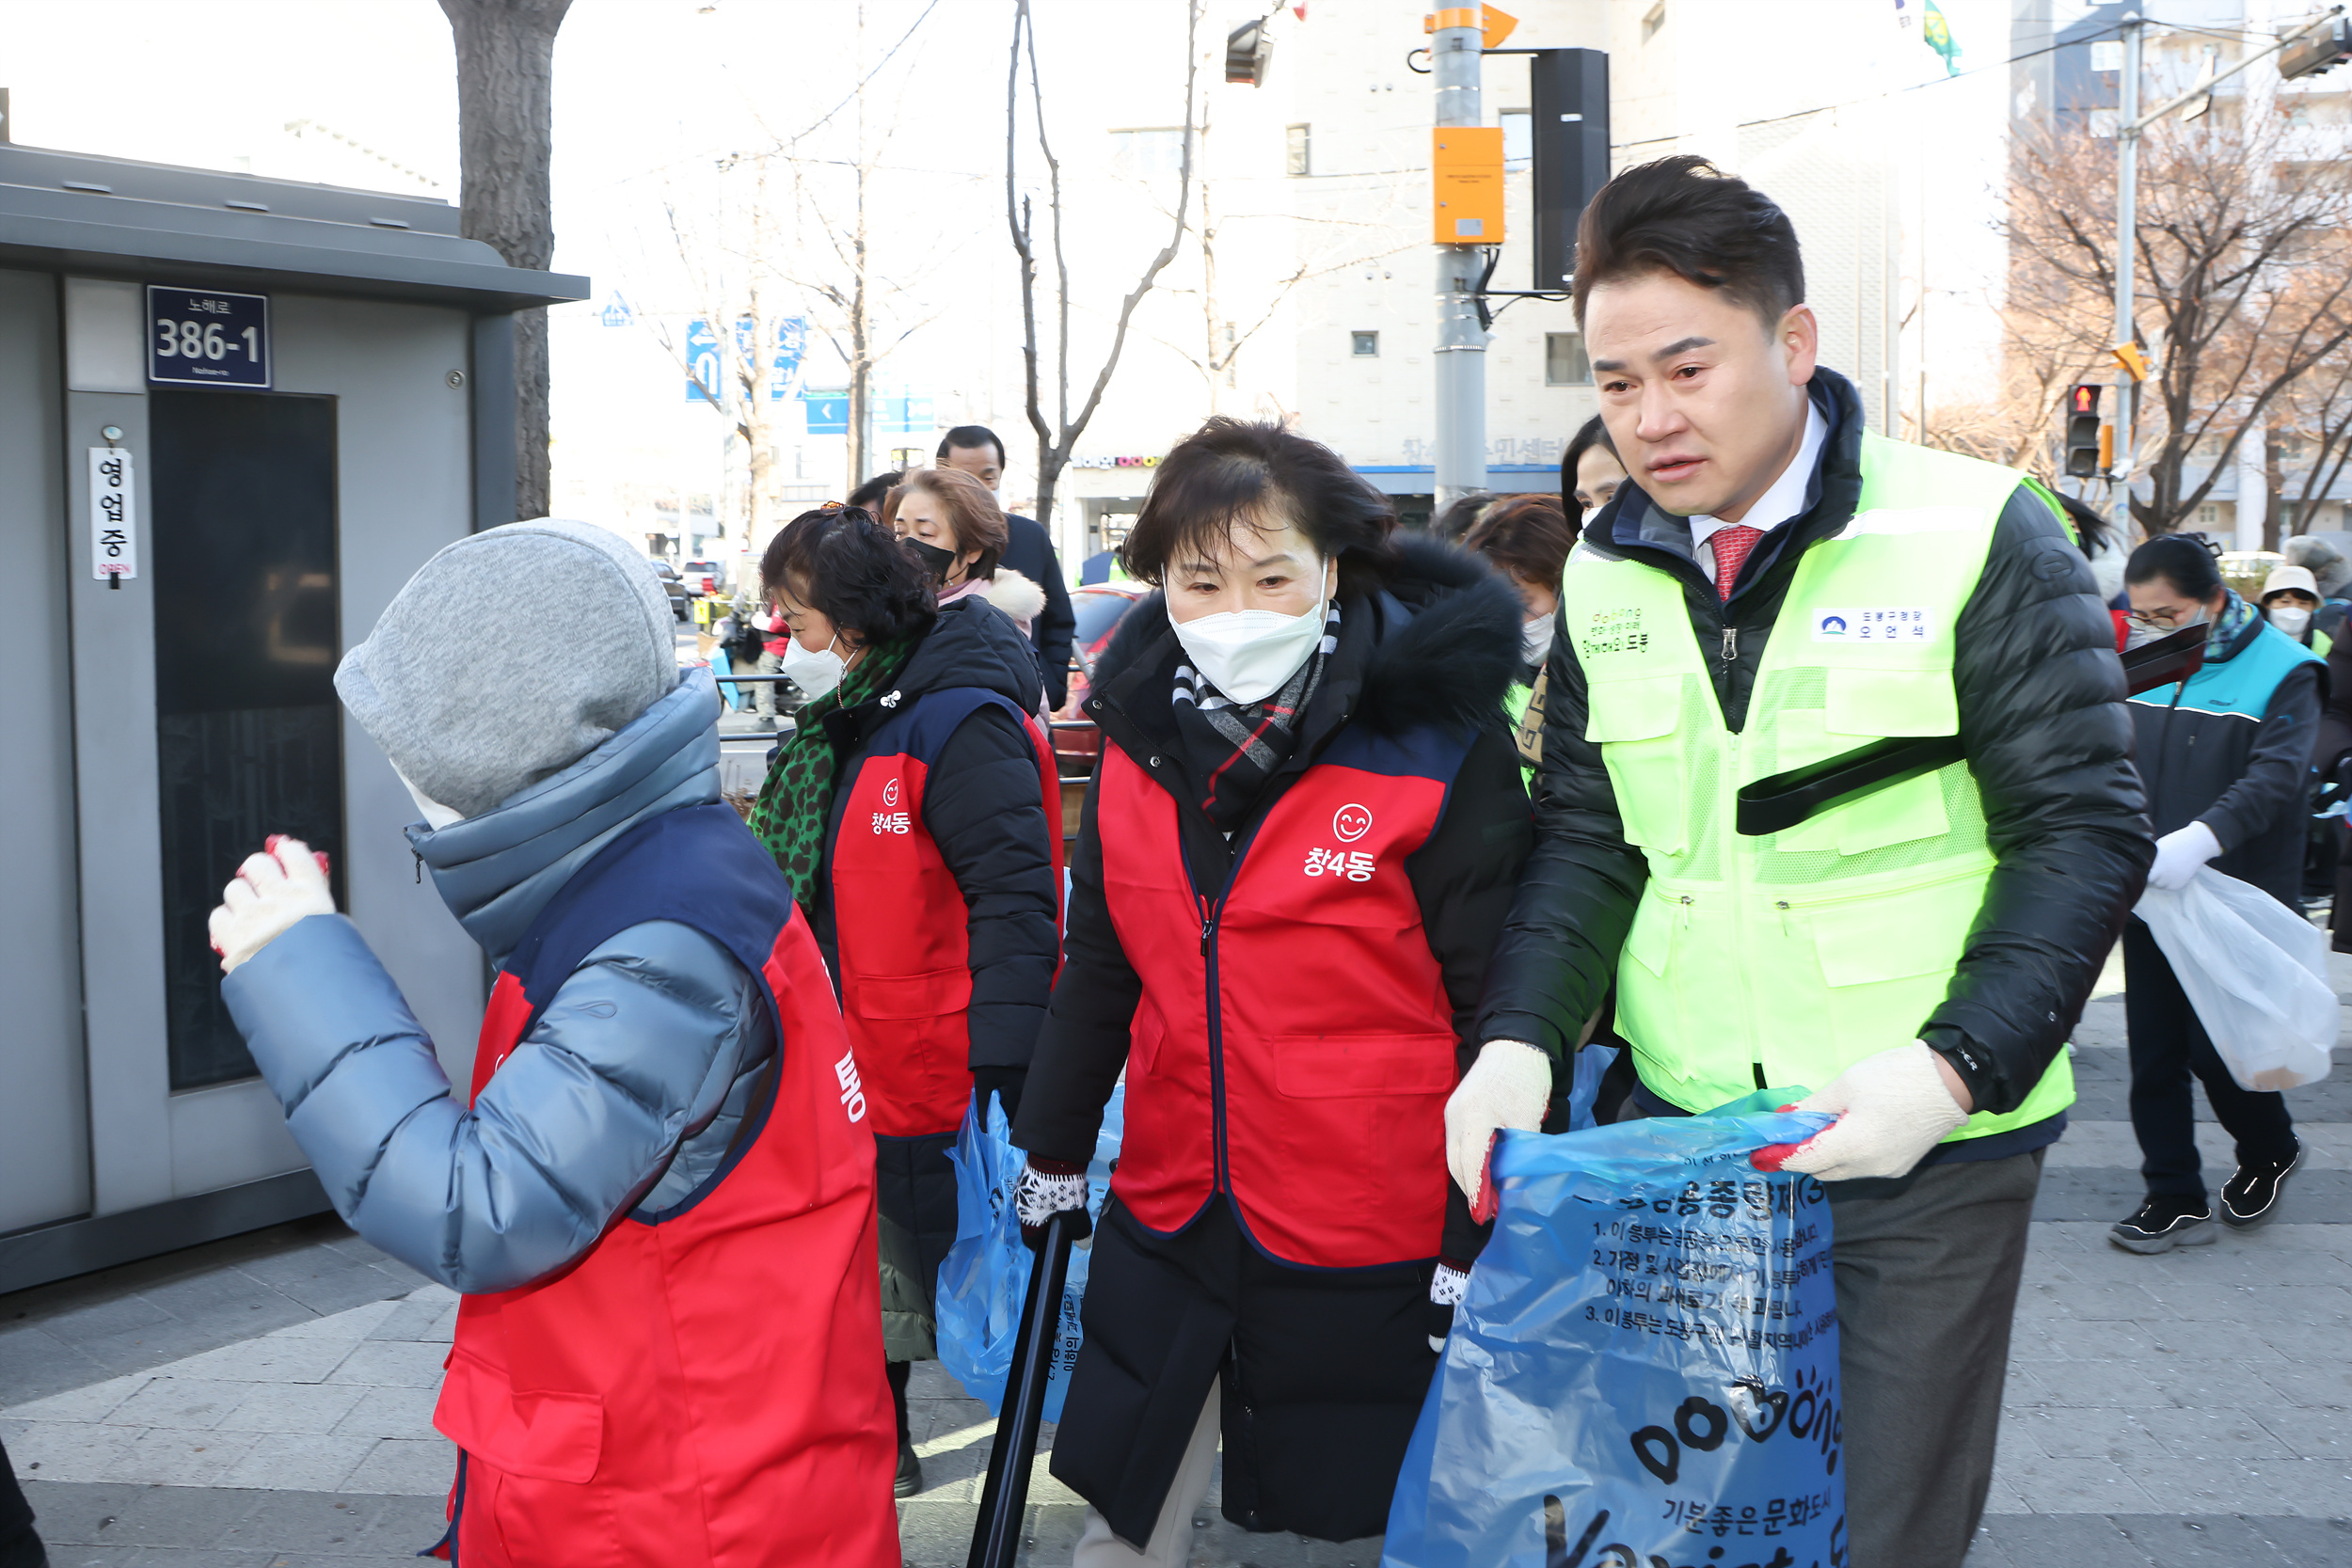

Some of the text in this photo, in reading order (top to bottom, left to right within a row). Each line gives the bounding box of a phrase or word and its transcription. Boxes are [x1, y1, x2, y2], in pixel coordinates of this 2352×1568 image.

[188, 298, 232, 314] 노해로
[157, 318, 259, 363] 386-1
[100, 457, 128, 558] 영업중
[1626, 632, 1648, 654] 도봉
[1859, 625, 1925, 639] 오언석
[871, 812, 911, 835] 창4동
[1303, 847, 1376, 882] 창4동
[1611, 1221, 1626, 1241] 이
[1628, 1223, 1674, 1246] 봉투는
[1593, 1249, 1605, 1266] 2.
[1608, 1250, 1640, 1272] 가정
[1645, 1254, 1661, 1275] 및
[1606, 1277, 1651, 1303] 이하의
[1584, 1306, 1599, 1323] 3.
[1604, 1307, 1620, 1326] 이
[1620, 1310, 1662, 1335] 봉투는
